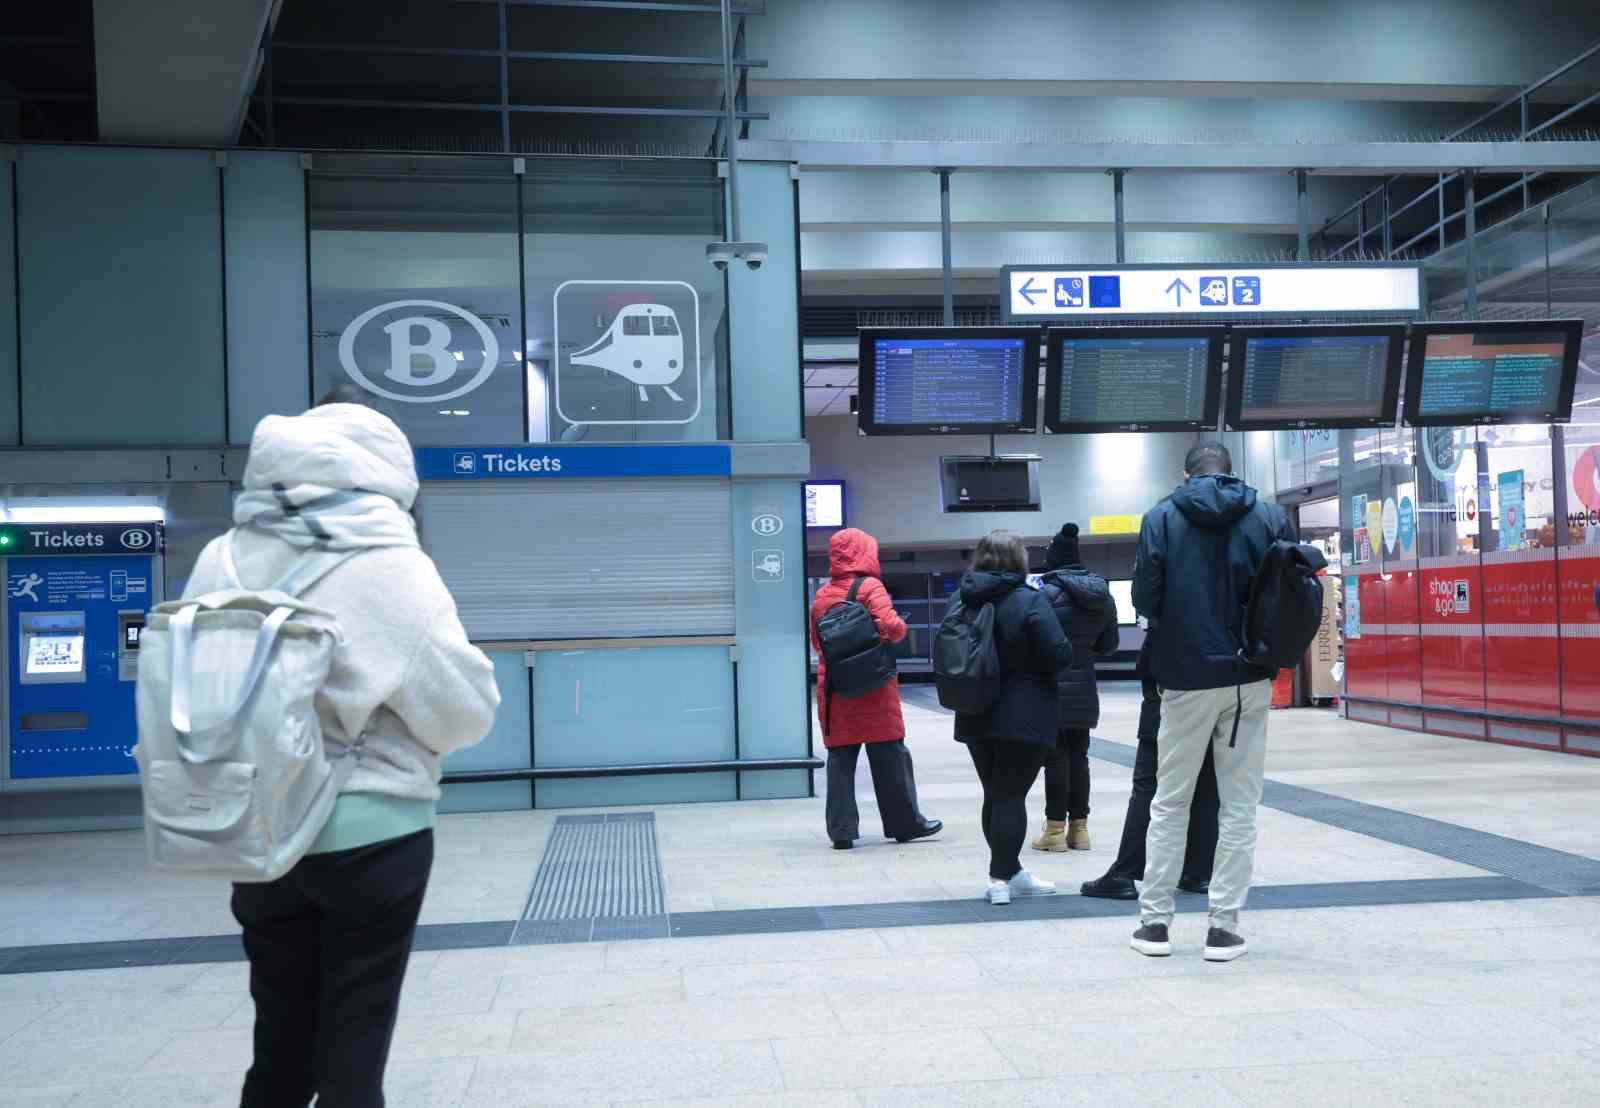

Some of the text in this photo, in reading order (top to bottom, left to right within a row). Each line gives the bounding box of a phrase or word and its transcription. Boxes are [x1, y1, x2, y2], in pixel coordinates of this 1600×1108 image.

[1242, 289, 1254, 303] 2
[383, 316, 459, 386] B
[483, 453, 562, 472] Tickets
[30, 531, 104, 547] Tickets
[1430, 576, 1454, 598] shop
[1434, 597, 1455, 617] &go
